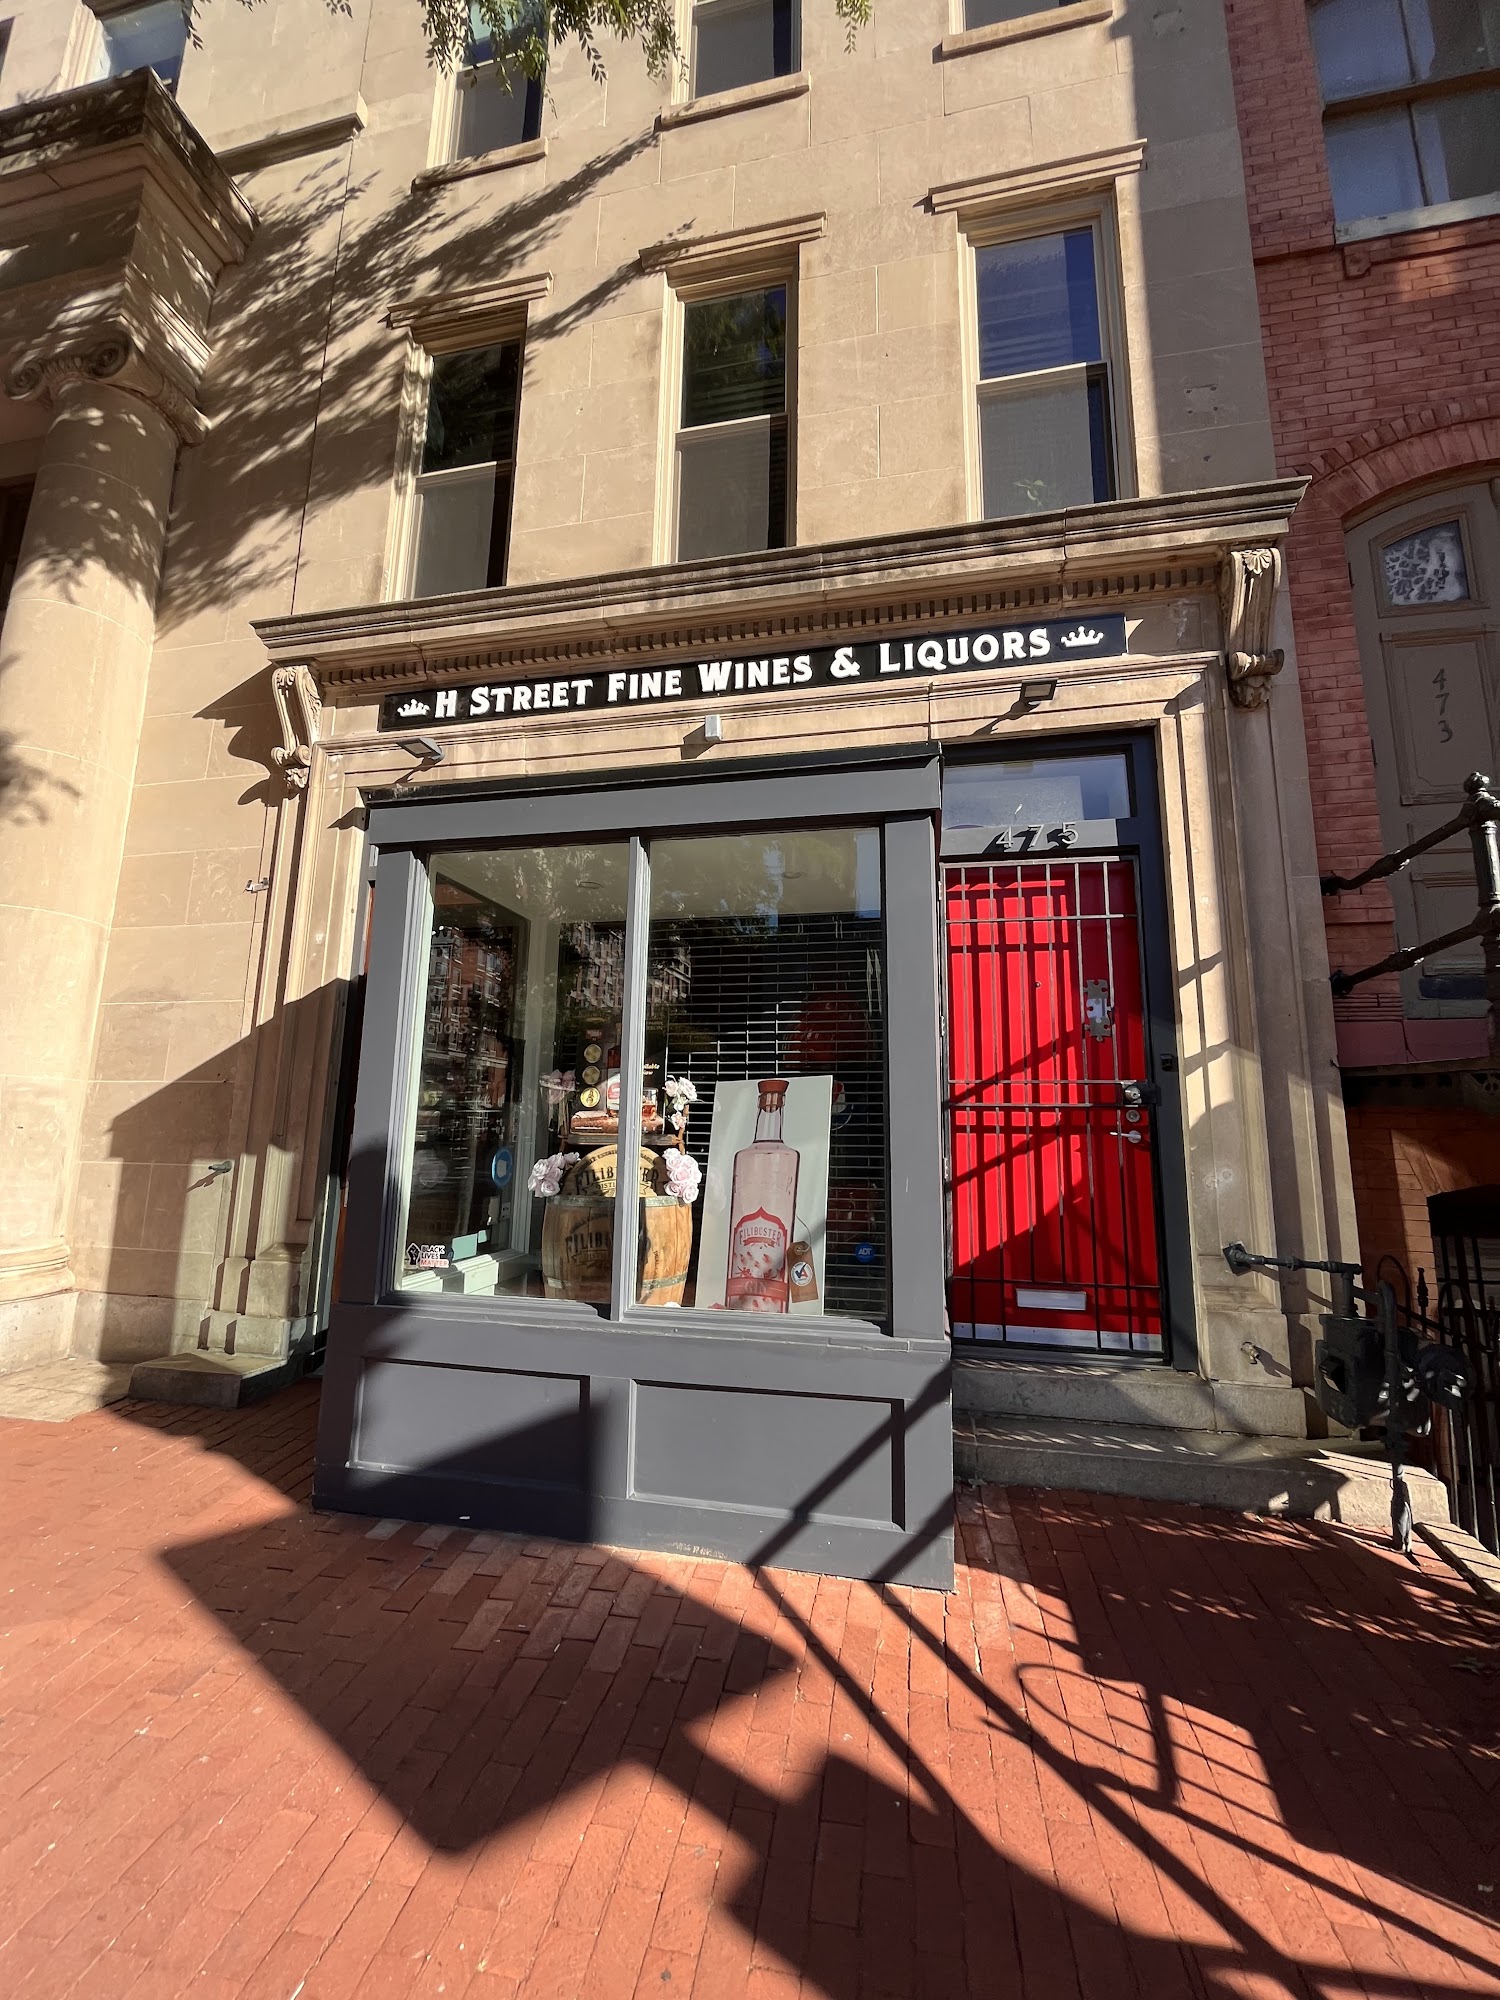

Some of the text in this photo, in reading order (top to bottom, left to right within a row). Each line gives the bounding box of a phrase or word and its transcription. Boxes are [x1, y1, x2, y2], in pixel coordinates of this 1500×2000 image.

[434, 628, 1051, 719] H STREET FINE WINES & LIQUORS
[1432, 668, 1453, 743] 473
[995, 821, 1079, 849] 475
[739, 1226, 782, 1247] FILIBUSTER
